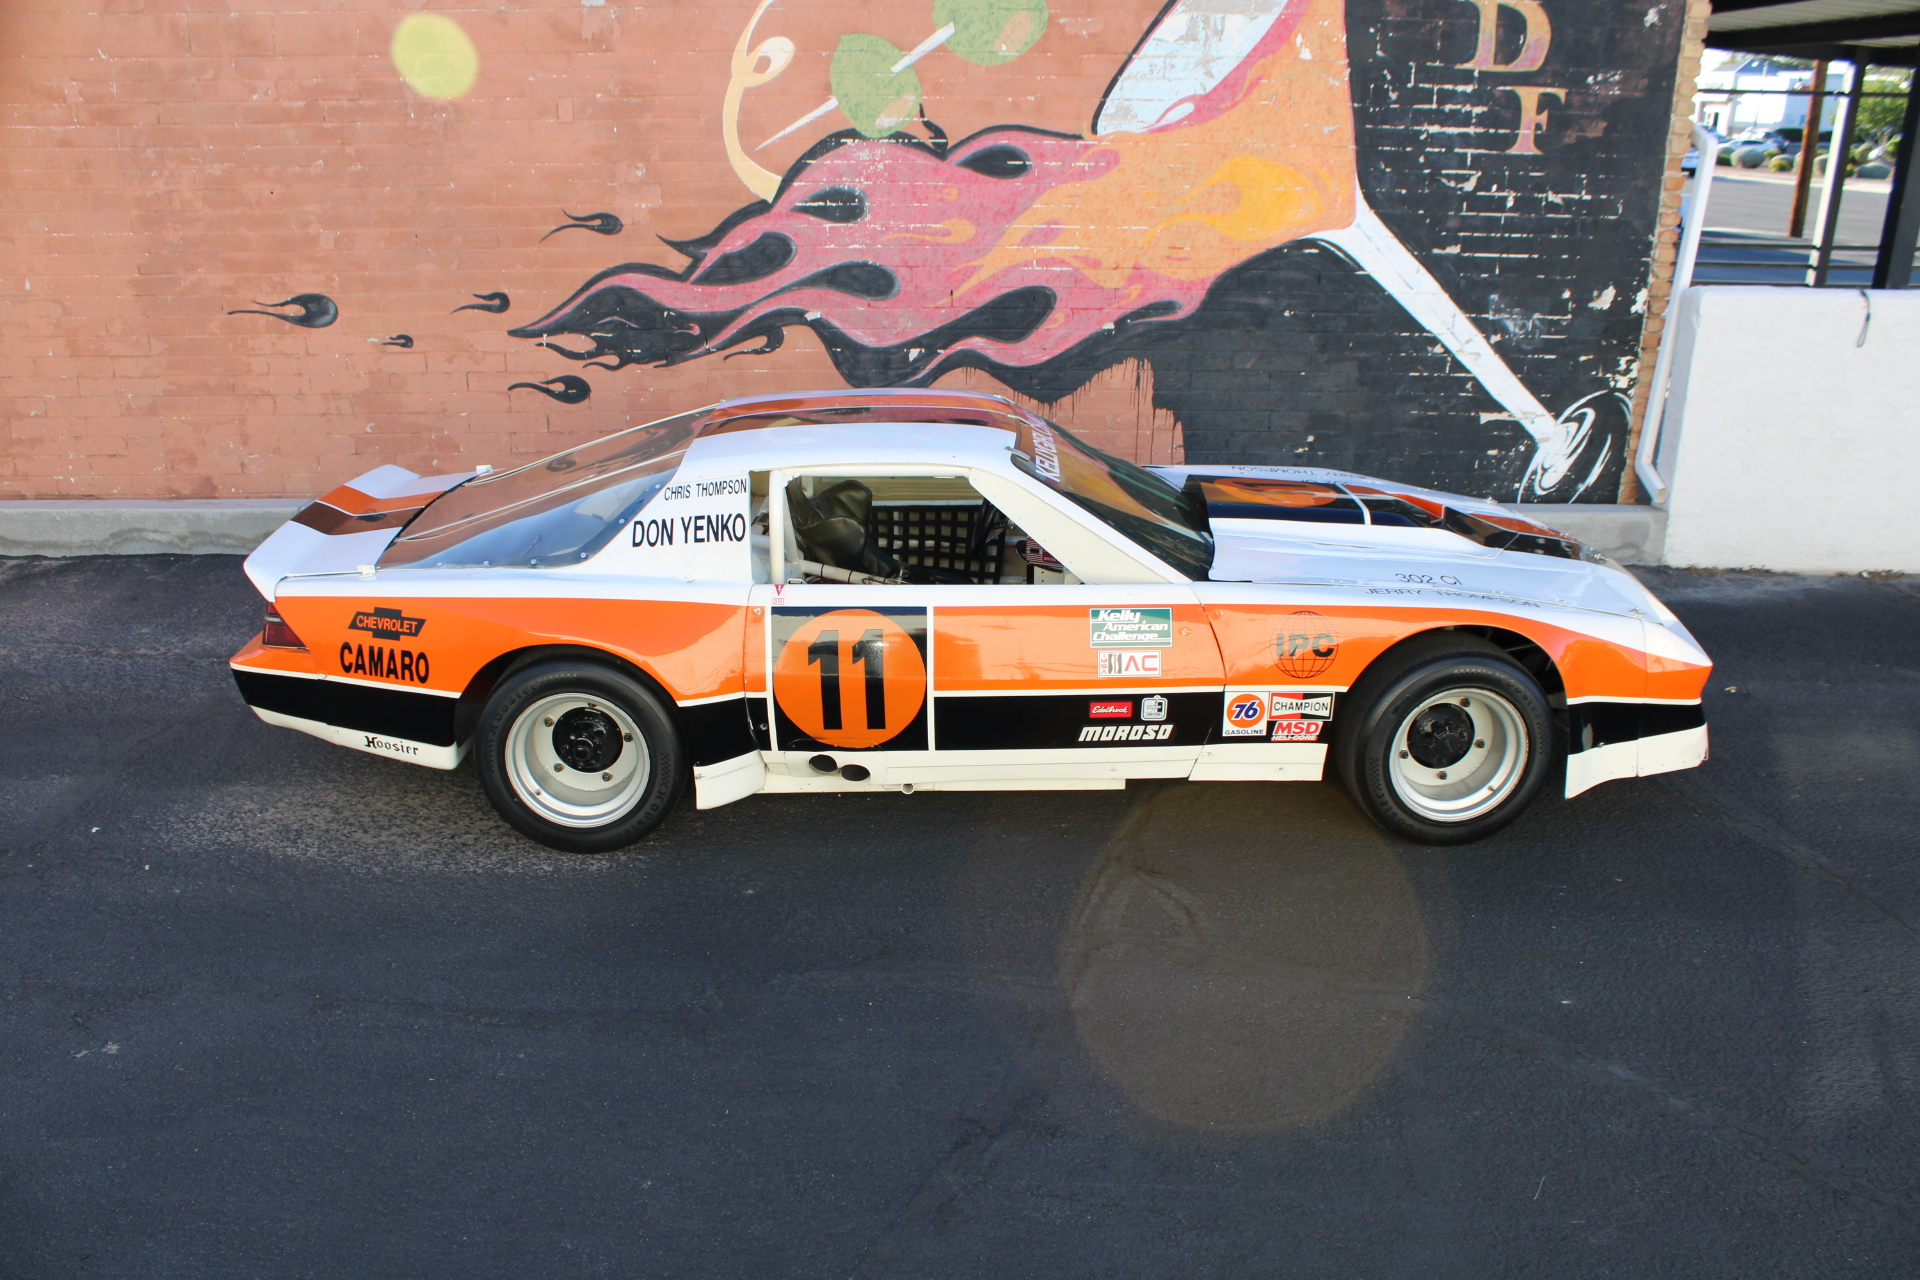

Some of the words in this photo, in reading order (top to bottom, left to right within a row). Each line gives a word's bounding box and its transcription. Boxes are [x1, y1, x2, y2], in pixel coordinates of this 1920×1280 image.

[1454, 0, 1552, 72] D
[1505, 86, 1569, 155] F
[664, 484, 691, 501] CHRIS
[696, 478, 747, 498] THOMPSON
[632, 518, 675, 548] DON
[680, 513, 746, 544] YENKO
[1395, 573, 1437, 585] 302
[1440, 575, 1463, 586] CI
[356, 615, 418, 633] CHEVROLET
[1097, 609, 1141, 623] Kelly
[1102, 620, 1169, 632] American
[1092, 632, 1159, 642] Challenge
[1276, 633, 1335, 657] IPC
[339, 641, 430, 684] CAMARO
[808, 629, 886, 730] 11
[1091, 705, 1129, 714] Edelbrock
[1231, 701, 1259, 720] 76
[1273, 702, 1329, 711] CHAMPION
[1078, 724, 1174, 741] MOROSO
[1274, 722, 1320, 734] MSD
[364, 735, 419, 756] Hoosier
